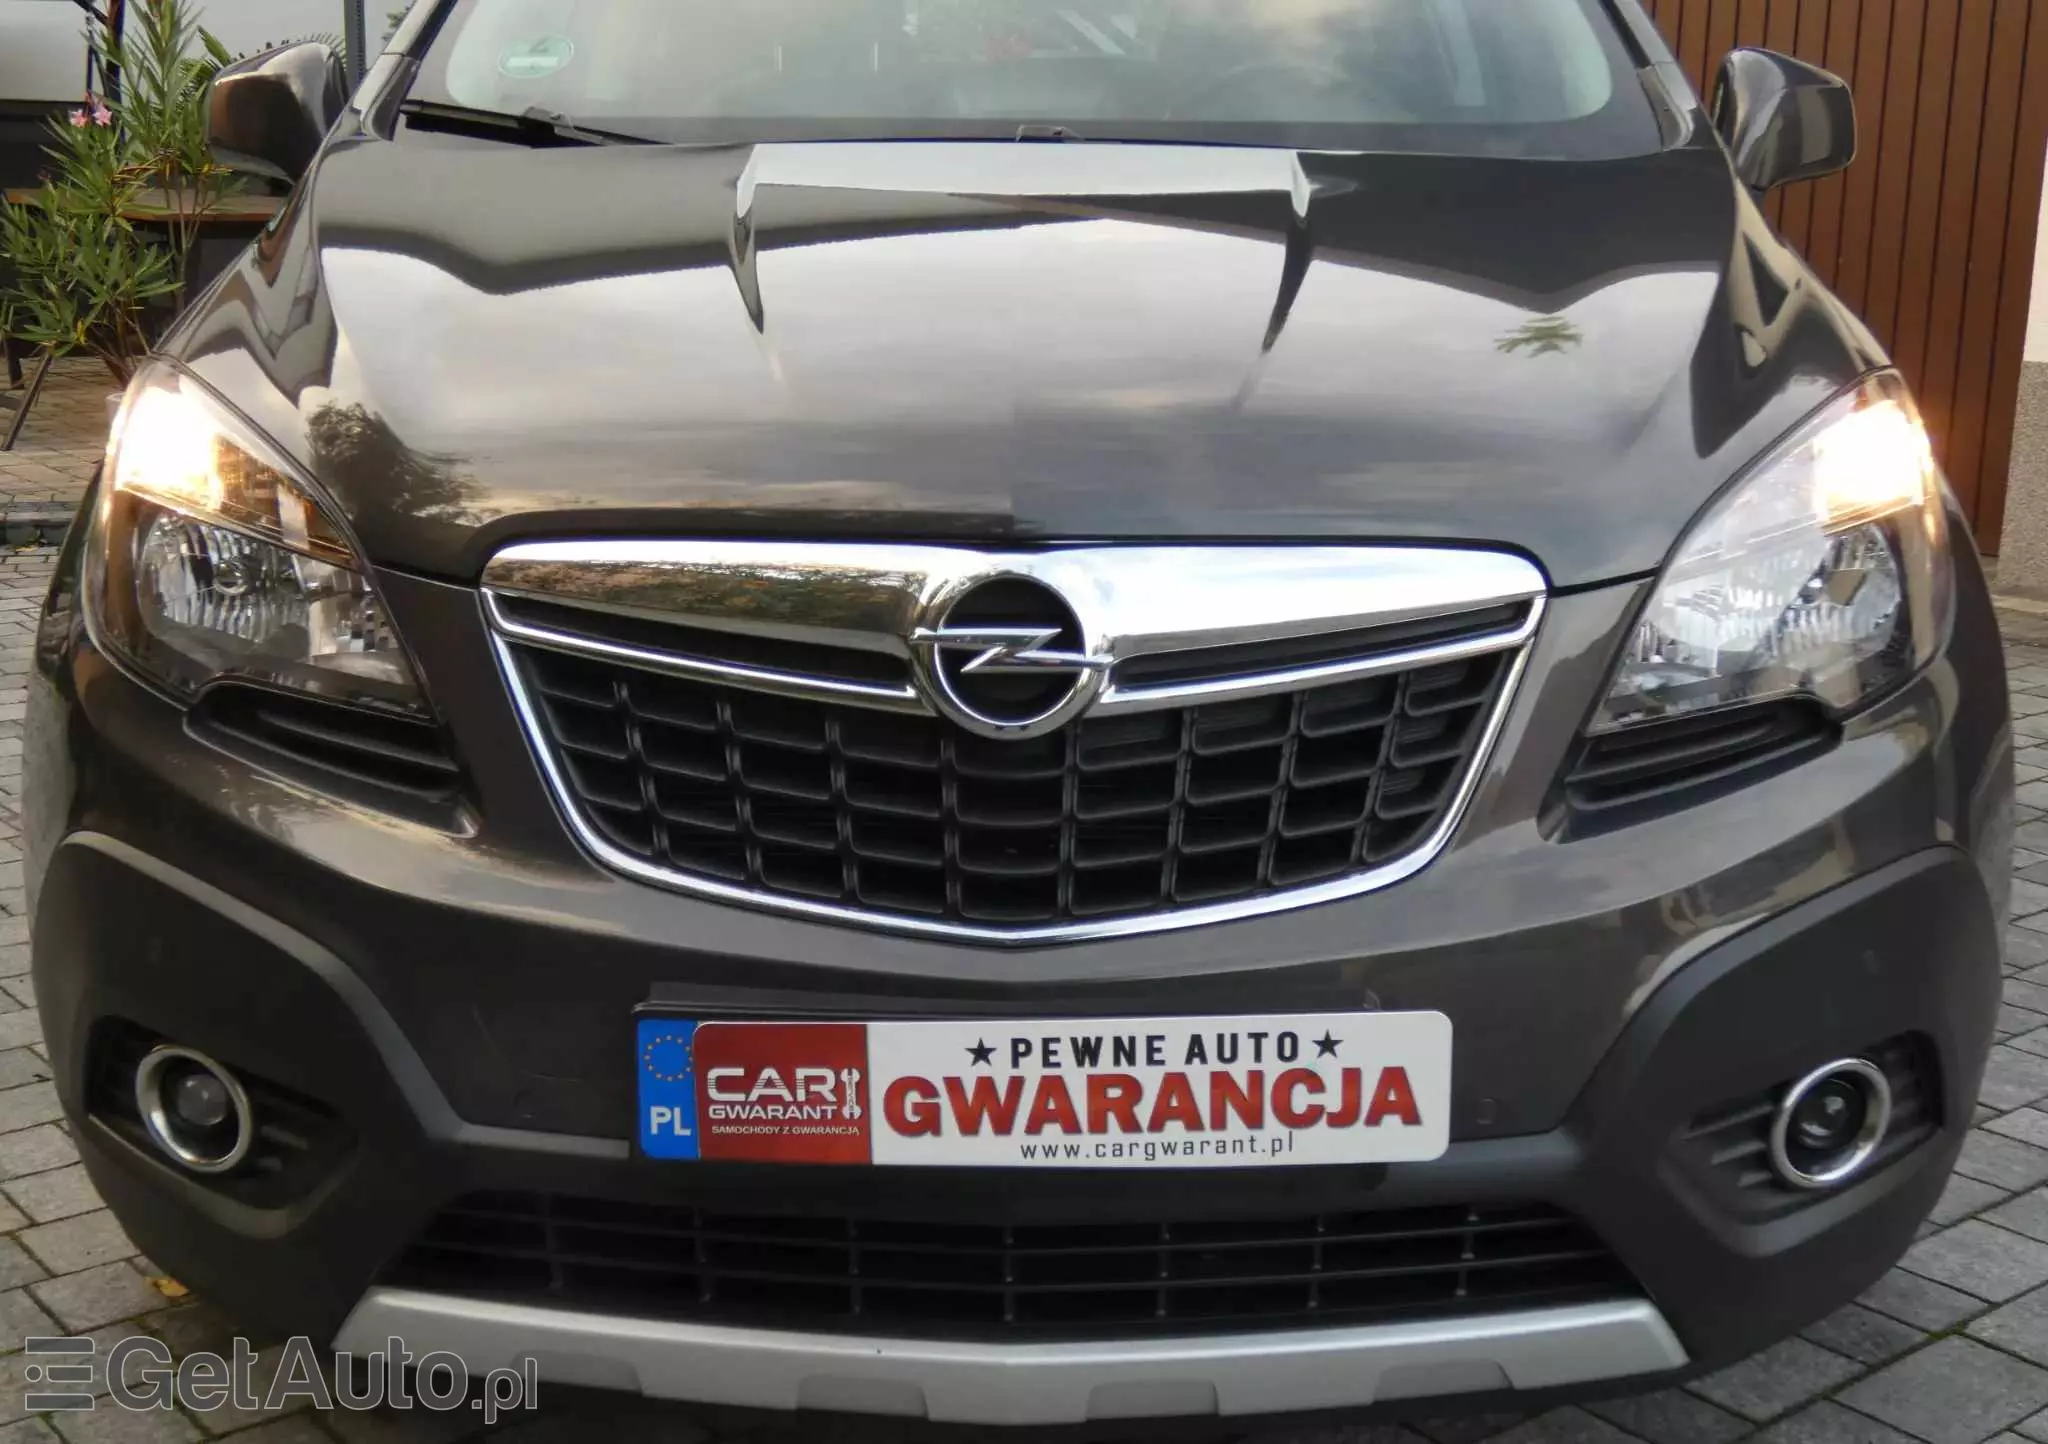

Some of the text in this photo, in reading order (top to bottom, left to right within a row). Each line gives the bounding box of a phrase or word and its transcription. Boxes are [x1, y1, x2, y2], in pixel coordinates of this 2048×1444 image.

[1010, 1031, 1300, 1069] PEWNE AUTO
[707, 1067, 837, 1102] CAR
[708, 1104, 838, 1120] GWARANT
[883, 1066, 1423, 1137] GWARANCJA
[650, 1105, 692, 1136] PL
[711, 1125, 860, 1137] SAMOCHODY Z GWARANCJĄ
[1020, 1131, 1294, 1161] www.cargwarant.pl
